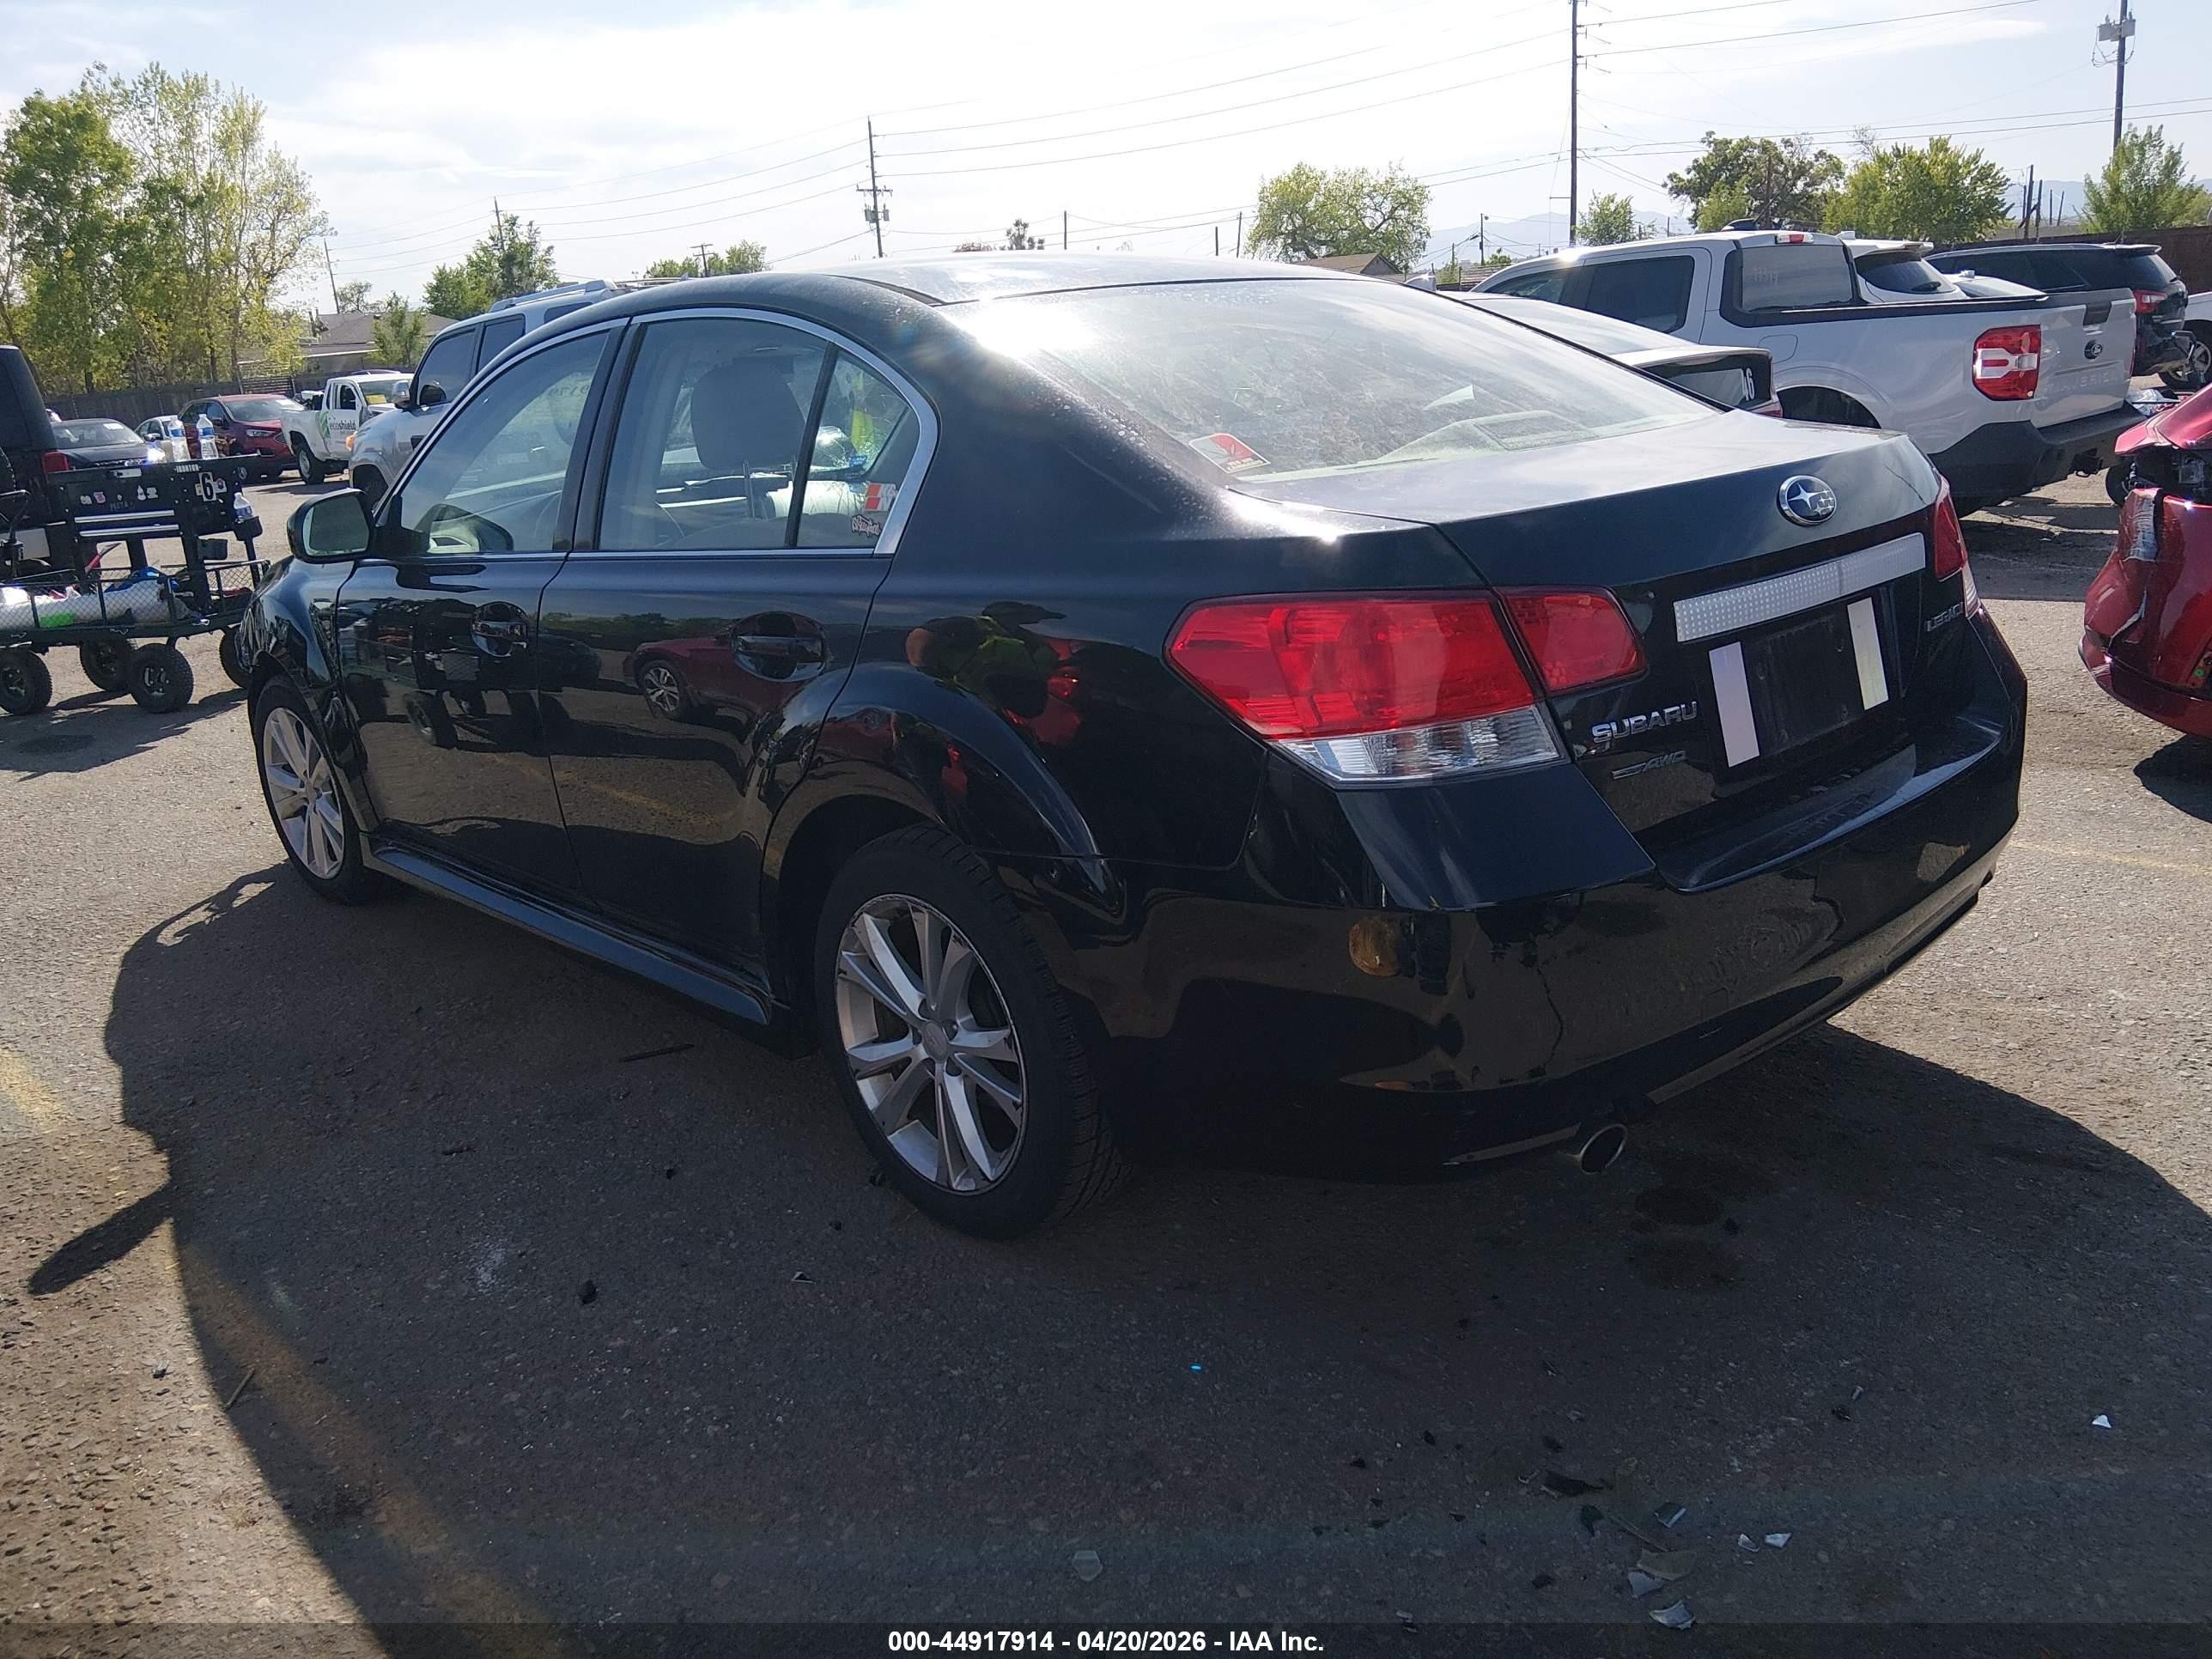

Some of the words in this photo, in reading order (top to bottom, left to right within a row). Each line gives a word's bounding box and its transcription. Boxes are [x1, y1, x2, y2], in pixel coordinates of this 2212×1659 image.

[330, 419, 356, 430] ecoshield
[201, 472, 215, 500] 6
[1591, 701, 1697, 744] SUBARU
